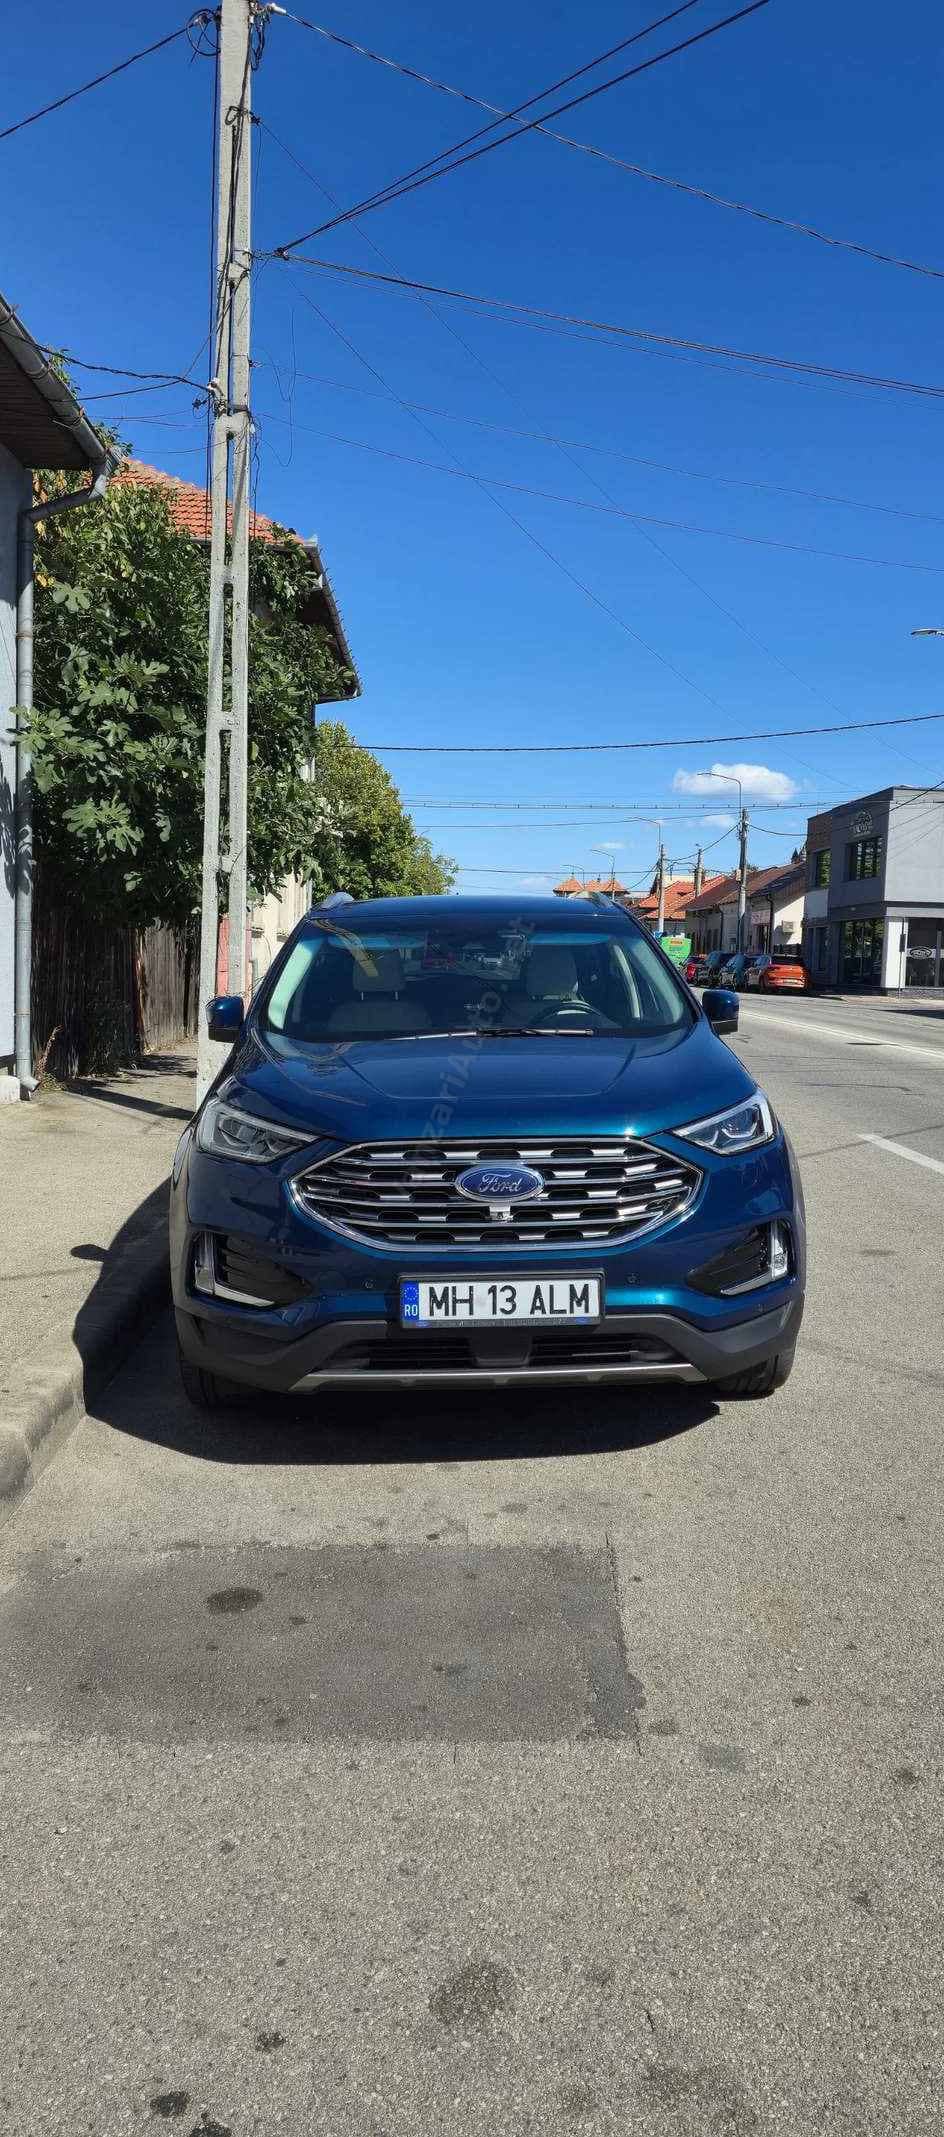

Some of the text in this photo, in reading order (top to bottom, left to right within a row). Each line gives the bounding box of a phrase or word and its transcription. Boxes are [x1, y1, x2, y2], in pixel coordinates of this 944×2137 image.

[478, 1173, 522, 1193] Ford
[428, 1283, 590, 1317] MH 13 ALM
[404, 1304, 418, 1317] RO
